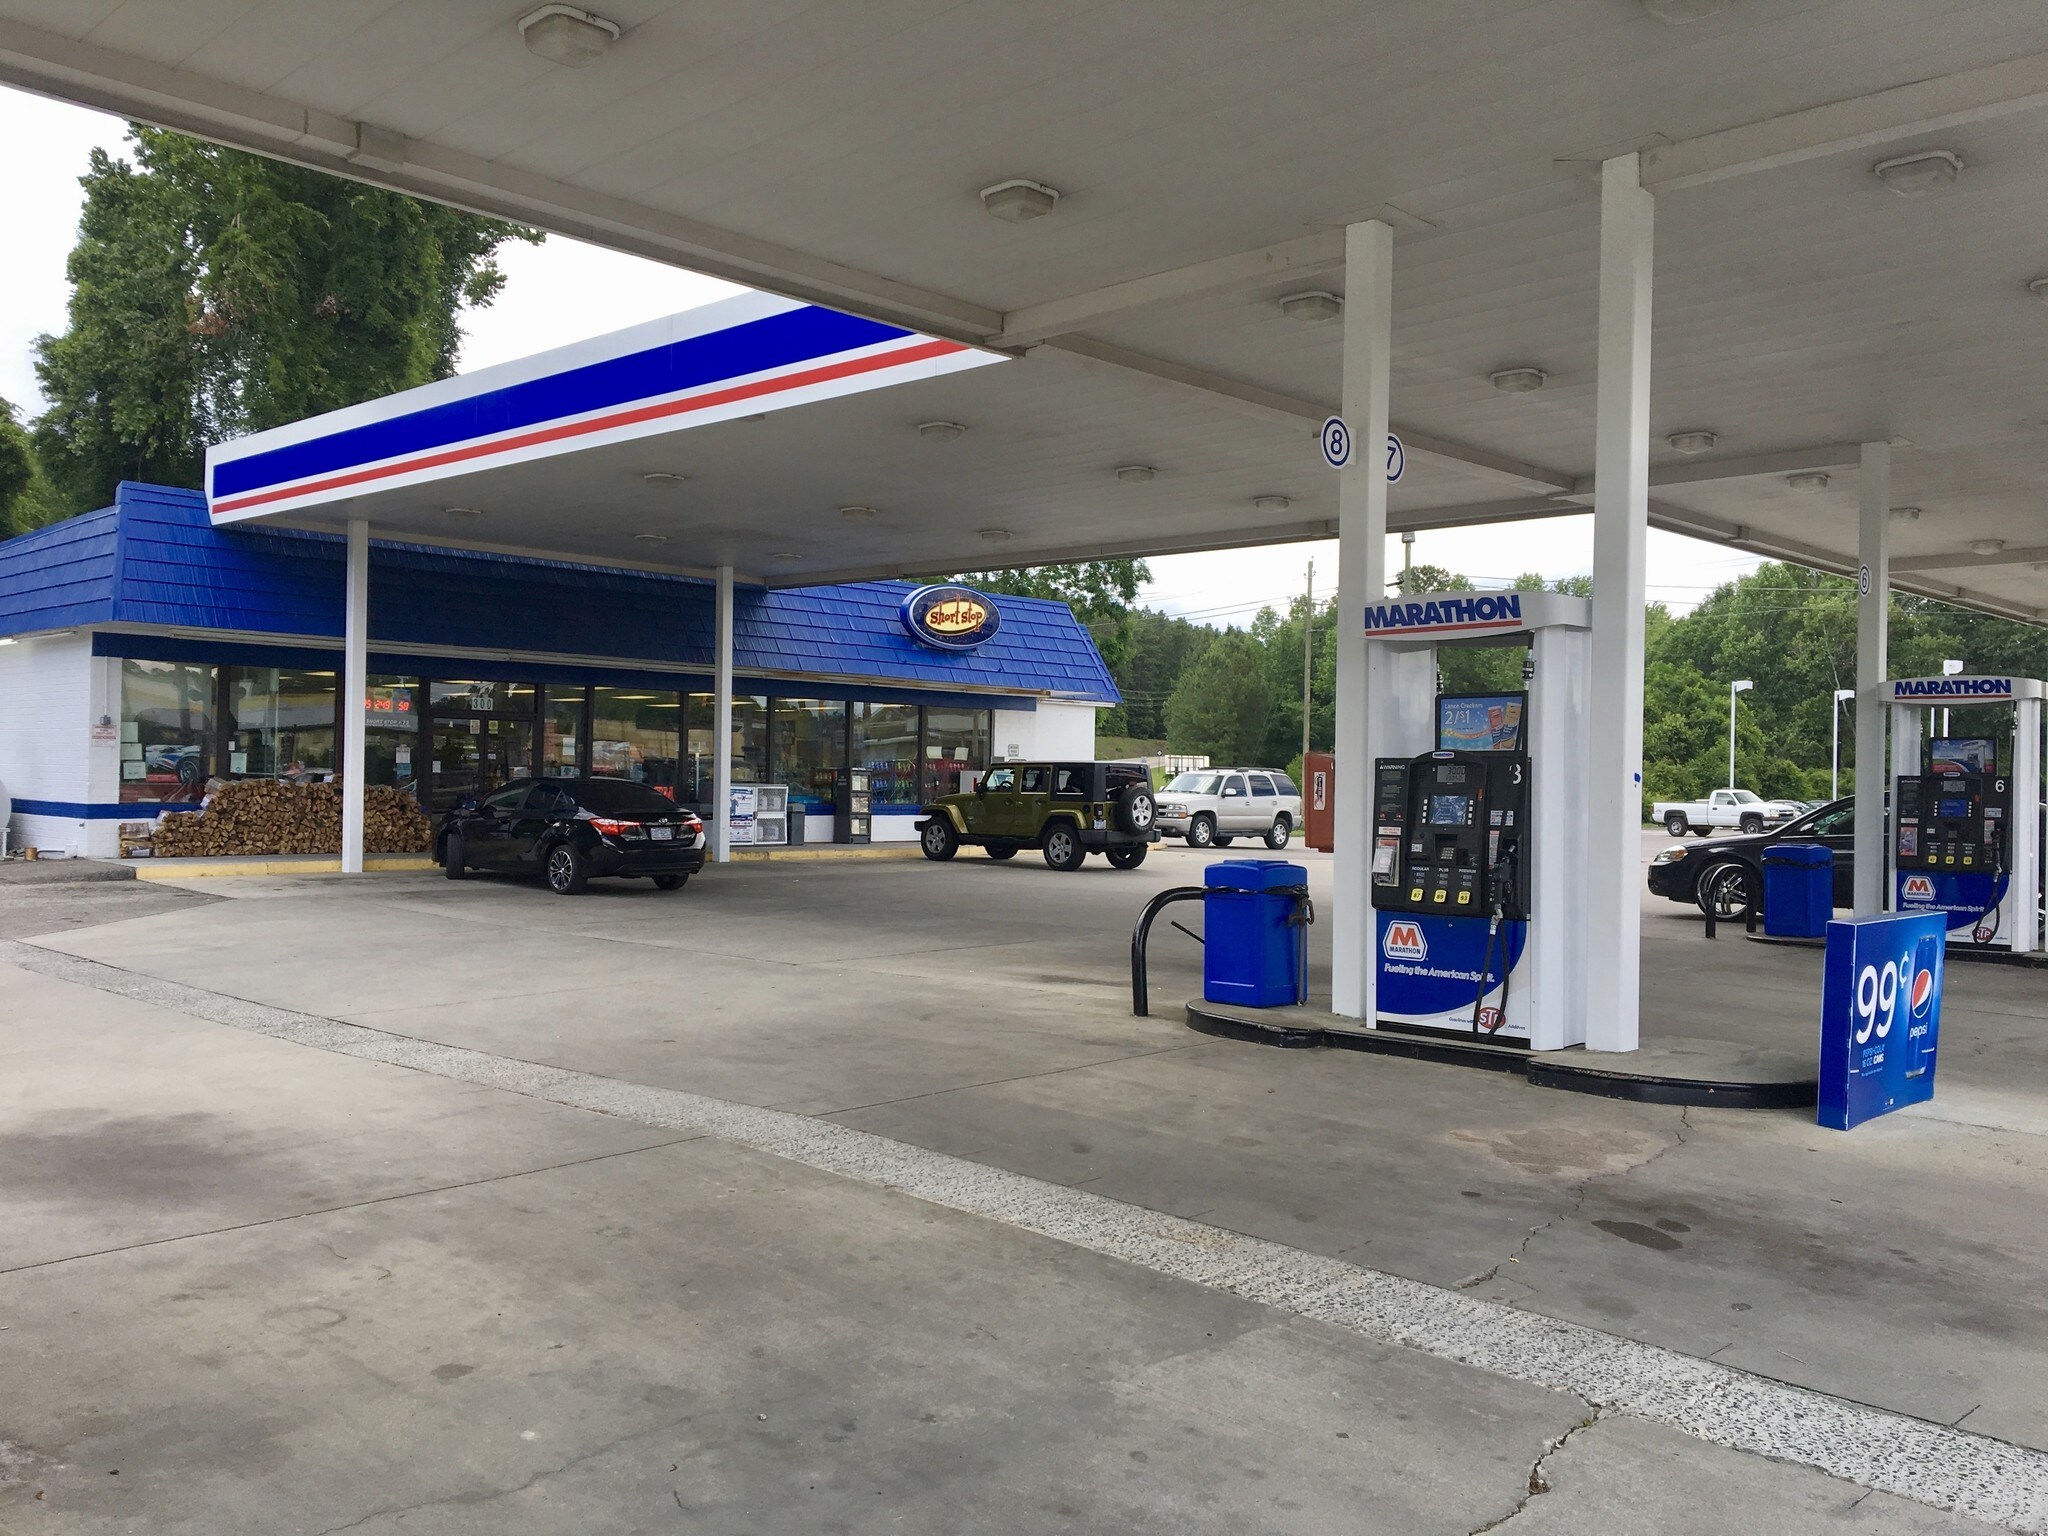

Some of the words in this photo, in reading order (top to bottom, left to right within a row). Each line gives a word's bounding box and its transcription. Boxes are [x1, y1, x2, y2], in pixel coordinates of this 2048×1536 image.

[1330, 429, 1343, 456] 8
[1387, 445, 1397, 470] 7
[1861, 572, 1868, 589] 6
[1364, 594, 1522, 630] MARATHON
[1894, 679, 2012, 696] MARATHON
[473, 698, 492, 710] 300
[1995, 780, 2005, 793] 6
[1902, 902, 1926, 912] Fueling
[1926, 902, 1936, 910] the
[1936, 904, 1967, 912] American
[1967, 905, 1985, 913] Spirit
[1391, 926, 1420, 947] M
[1389, 946, 1421, 955] MARATHON
[1384, 963, 1414, 976] Fueling
[1414, 965, 1428, 976] the
[1428, 967, 1470, 981] American
[1909, 1022, 1929, 1041] pepsi
[1873, 1053, 1885, 1065] CANS
